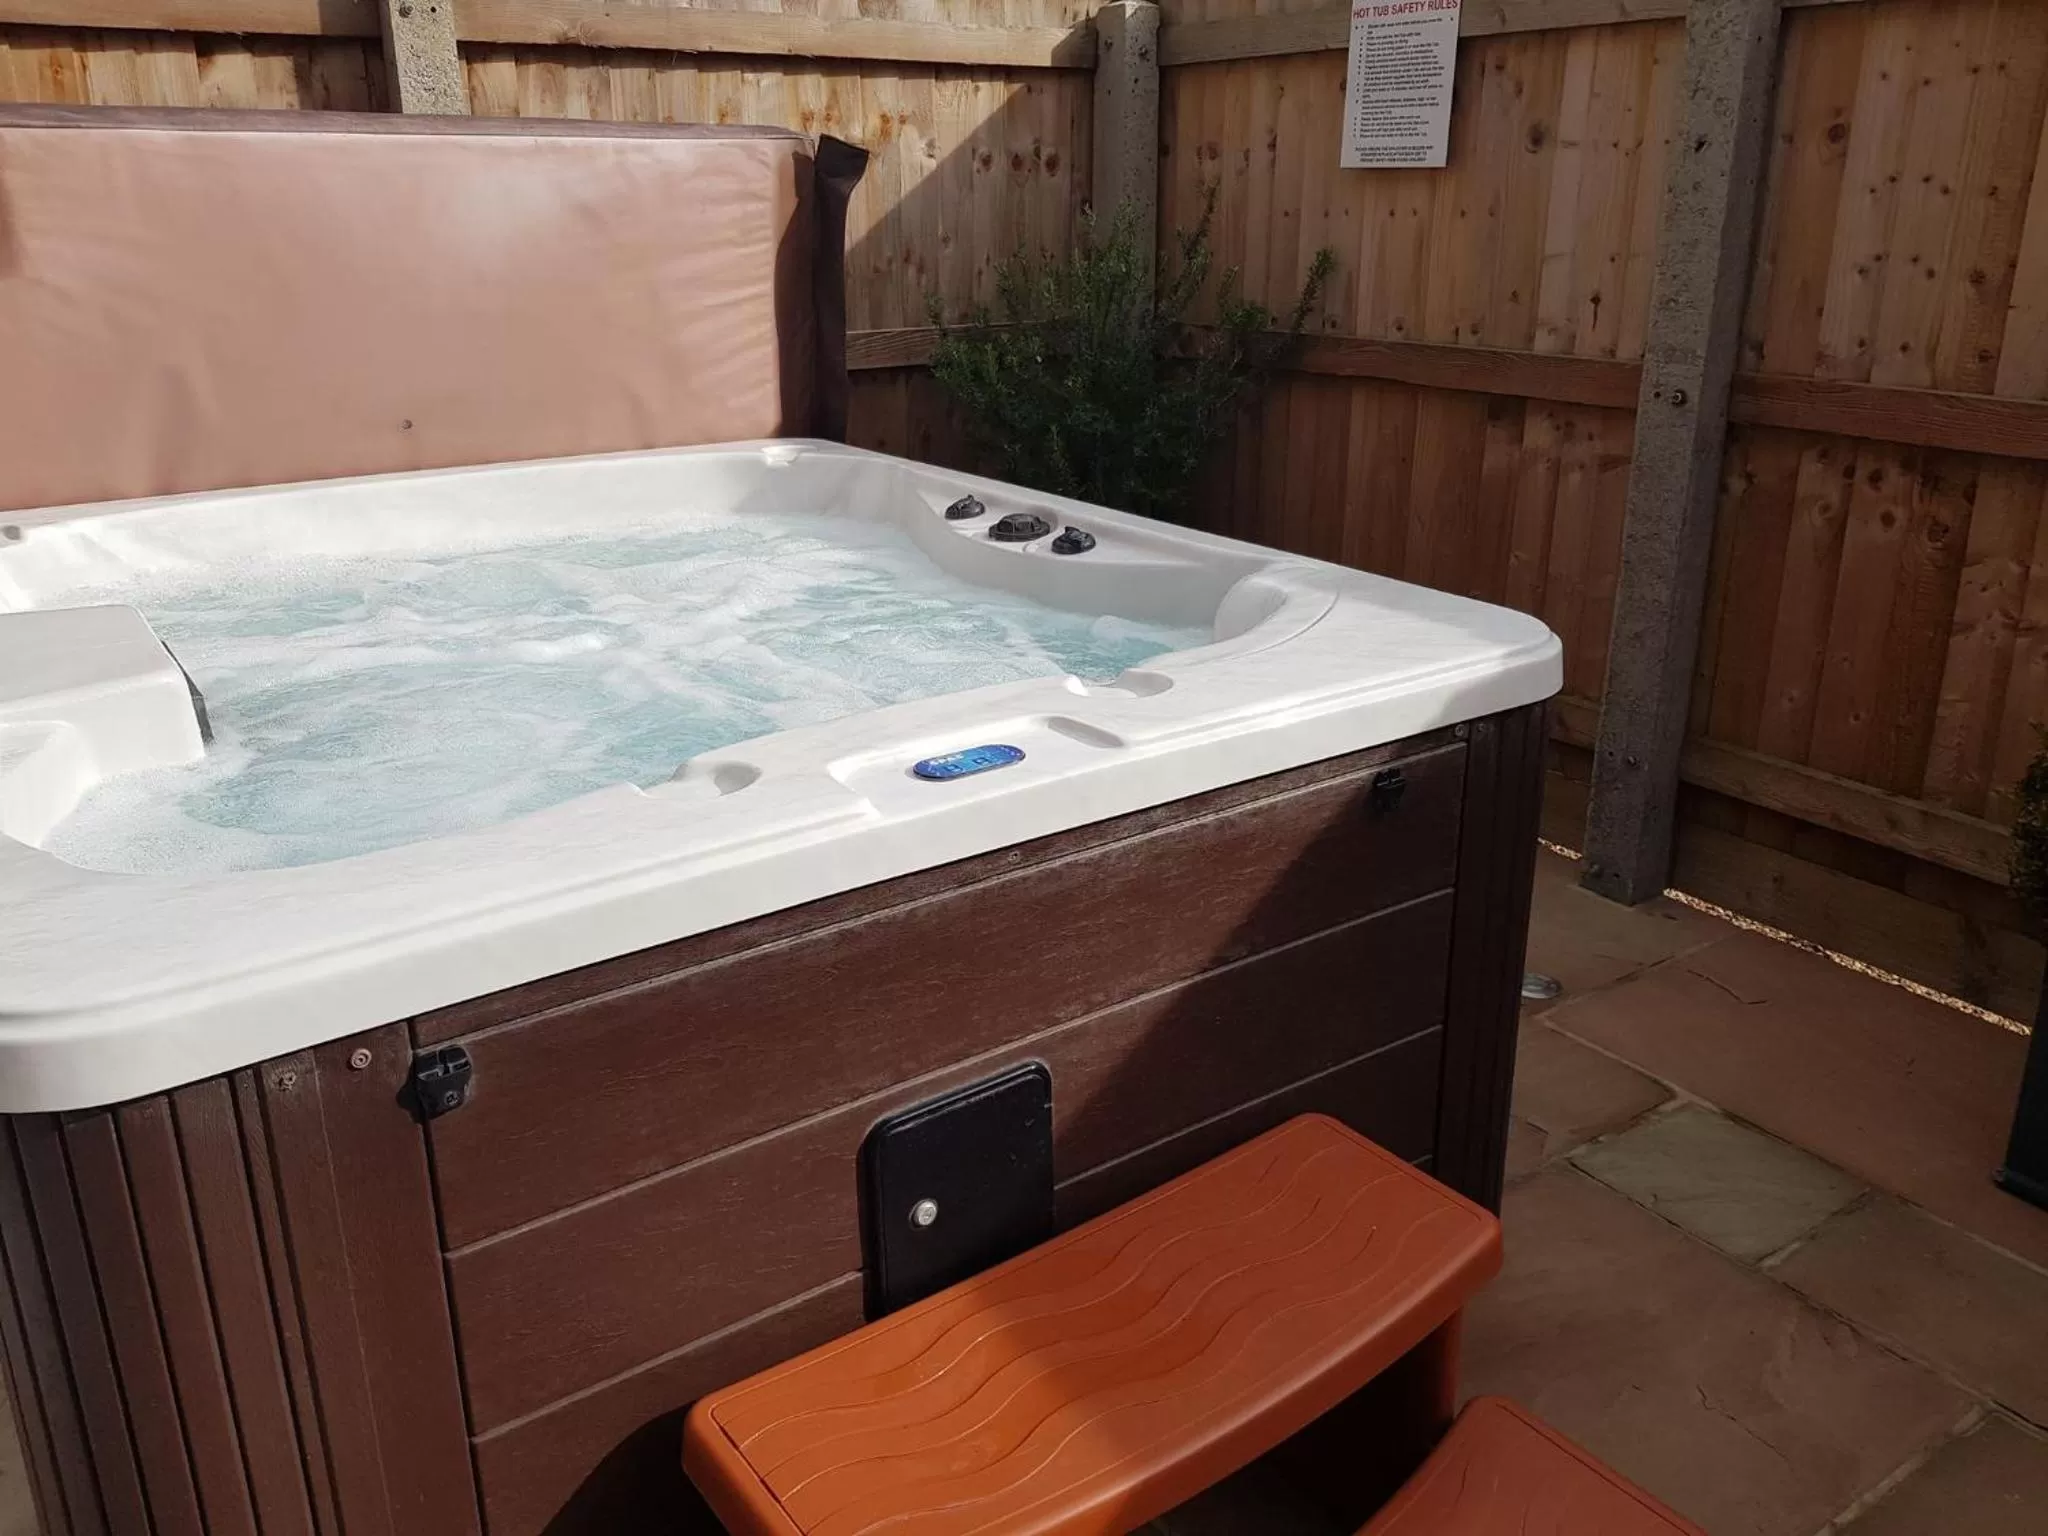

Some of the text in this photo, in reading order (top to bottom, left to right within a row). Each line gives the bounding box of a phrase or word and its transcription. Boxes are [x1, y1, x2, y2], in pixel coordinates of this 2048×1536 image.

[1353, 0, 1458, 19] HOT TUB SAFETY RULES
